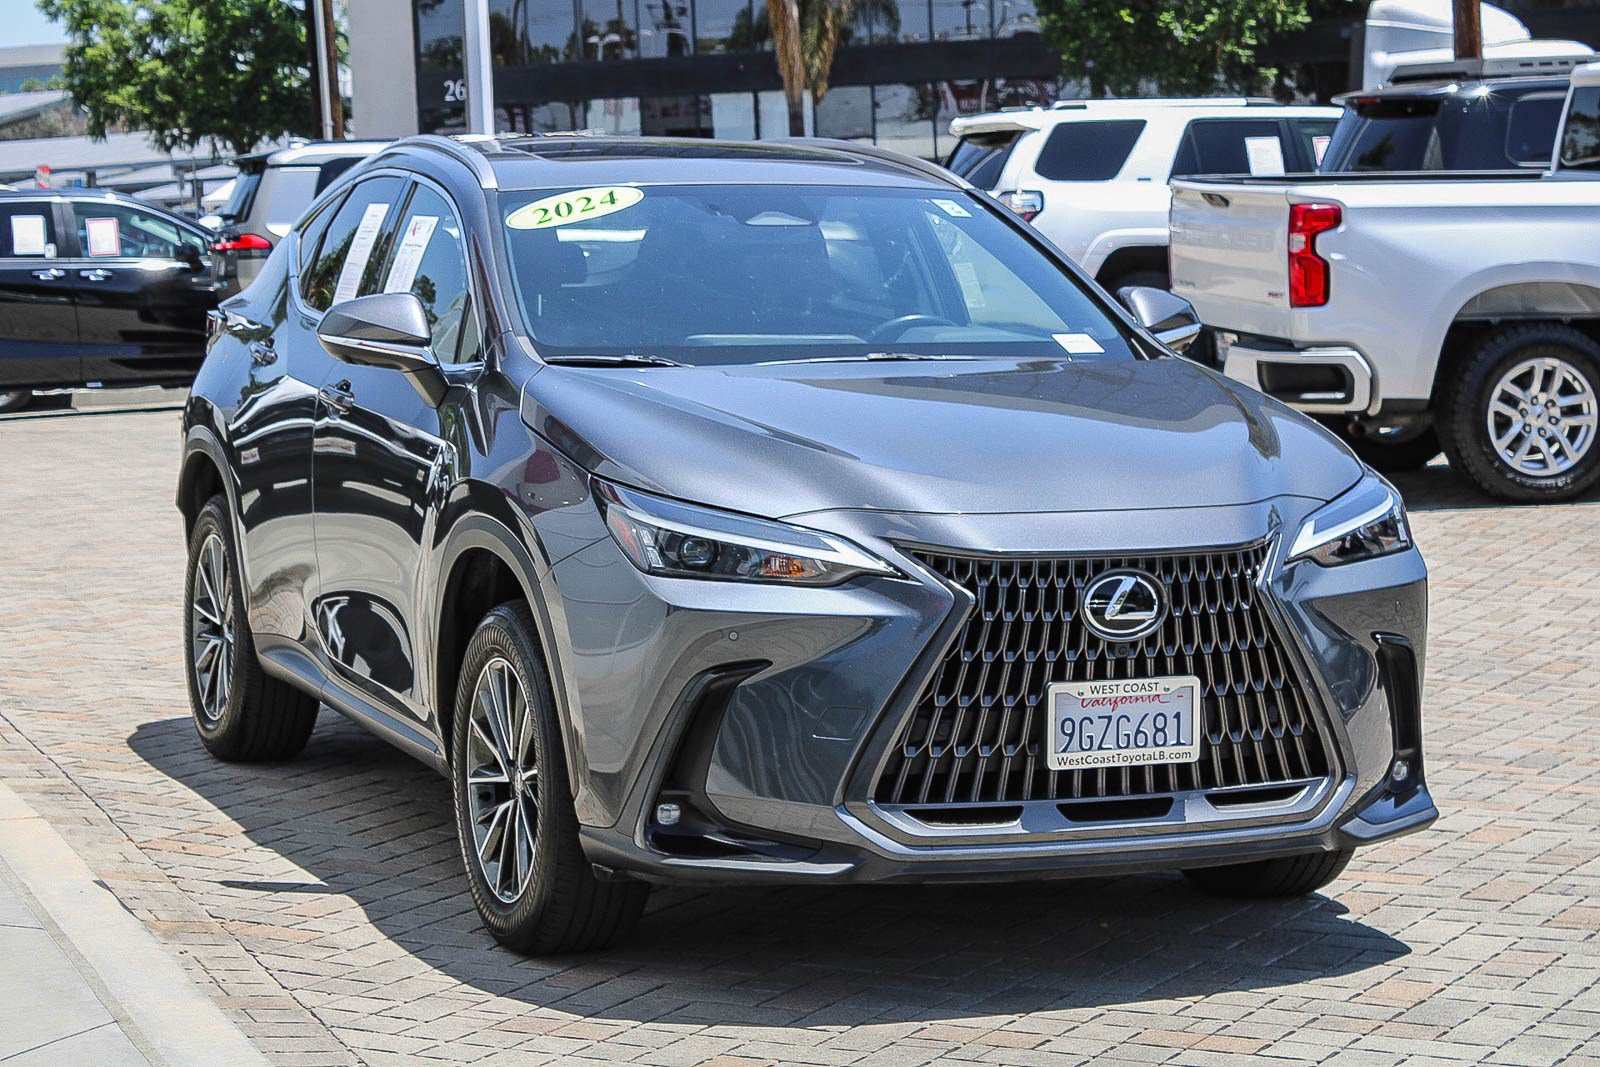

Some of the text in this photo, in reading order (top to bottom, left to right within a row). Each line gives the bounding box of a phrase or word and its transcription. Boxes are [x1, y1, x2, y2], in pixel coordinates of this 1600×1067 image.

[532, 190, 619, 225] 2024
[1089, 682, 1160, 695] WEST COAST
[1058, 711, 1187, 753] 9GZG681
[1056, 750, 1192, 766] WestCoastToyotaLB.com
